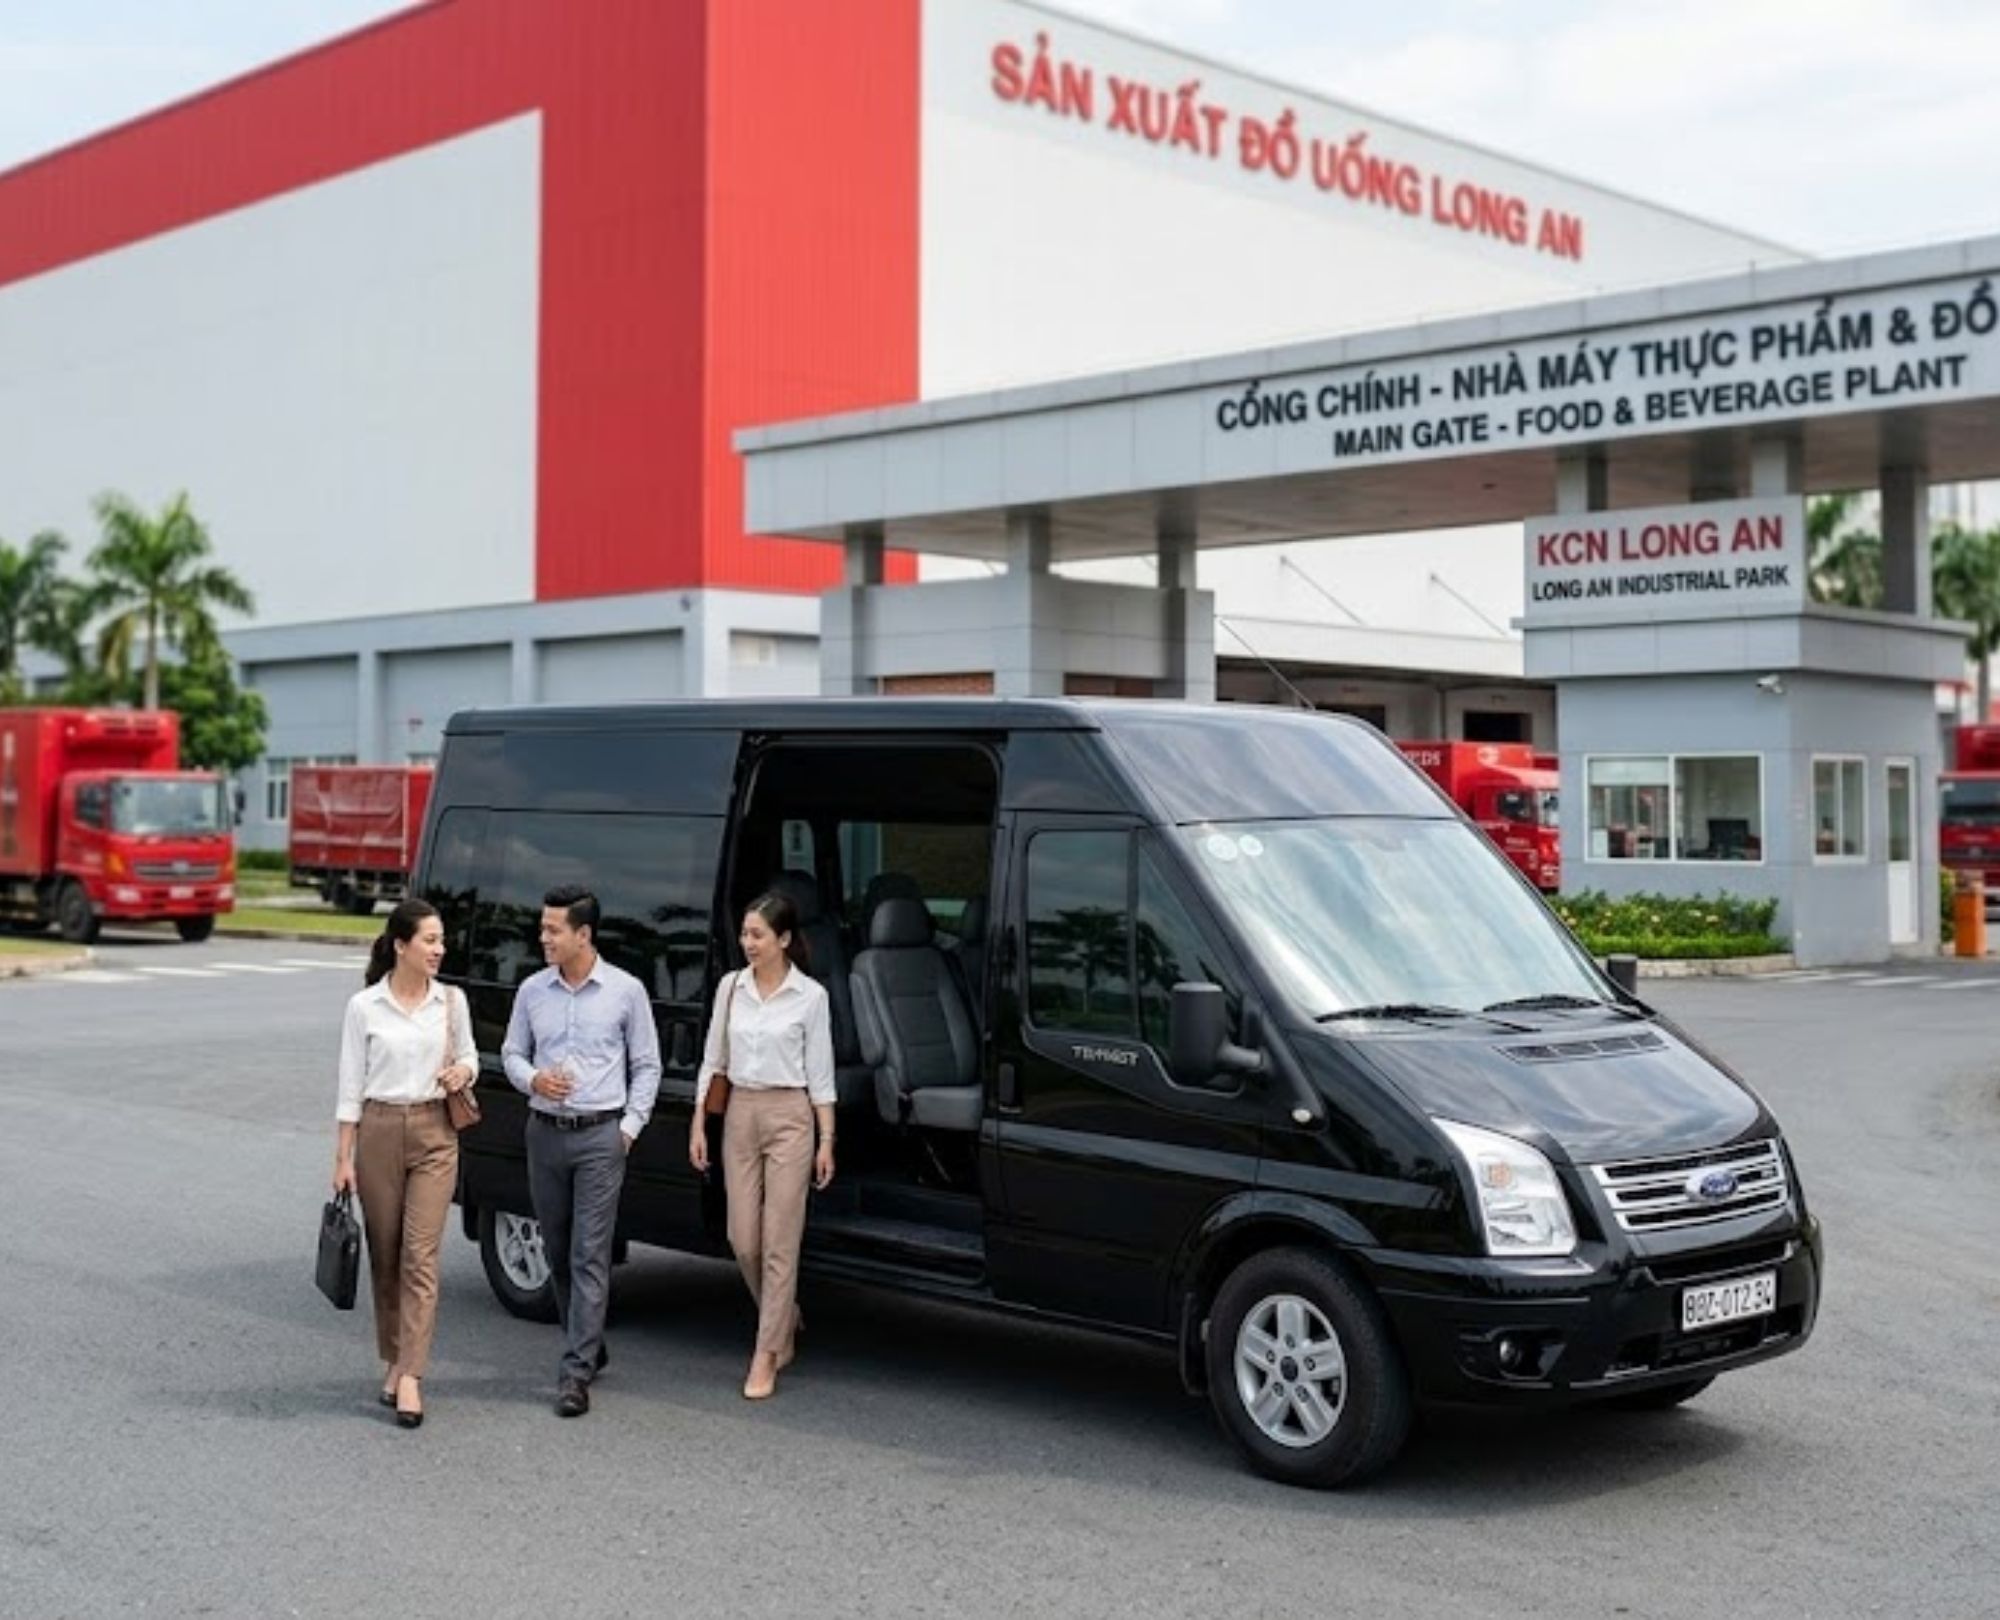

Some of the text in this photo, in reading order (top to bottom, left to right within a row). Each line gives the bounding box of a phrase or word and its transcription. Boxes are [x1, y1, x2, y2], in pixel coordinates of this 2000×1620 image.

[990, 30, 1095, 122] SẢN
[1107, 76, 1229, 159] XUẤT
[1311, 132, 1423, 218] UỐNG
[1432, 175, 1528, 246] LONG
[1537, 208, 1583, 263] AN
[1316, 369, 1421, 419] CHÍNH
[1452, 350, 1528, 401] NHÀ
[1538, 338, 1619, 390] MÁY
[1629, 328, 1738, 380] THỰC
[1887, 306, 1917, 346] &
[1334, 424, 1403, 457] MAIN
[1411, 412, 1489, 449] GATE
[1517, 399, 1604, 436] FOOD
[1613, 396, 1635, 426] &
[1645, 370, 1833, 422] BEVERAGE
[1845, 354, 1968, 399] PLANT
[1532, 564, 1788, 602] LONG AN INDUSTRIAL PARK
[1537, 514, 1783, 567] KCN LONG AN
